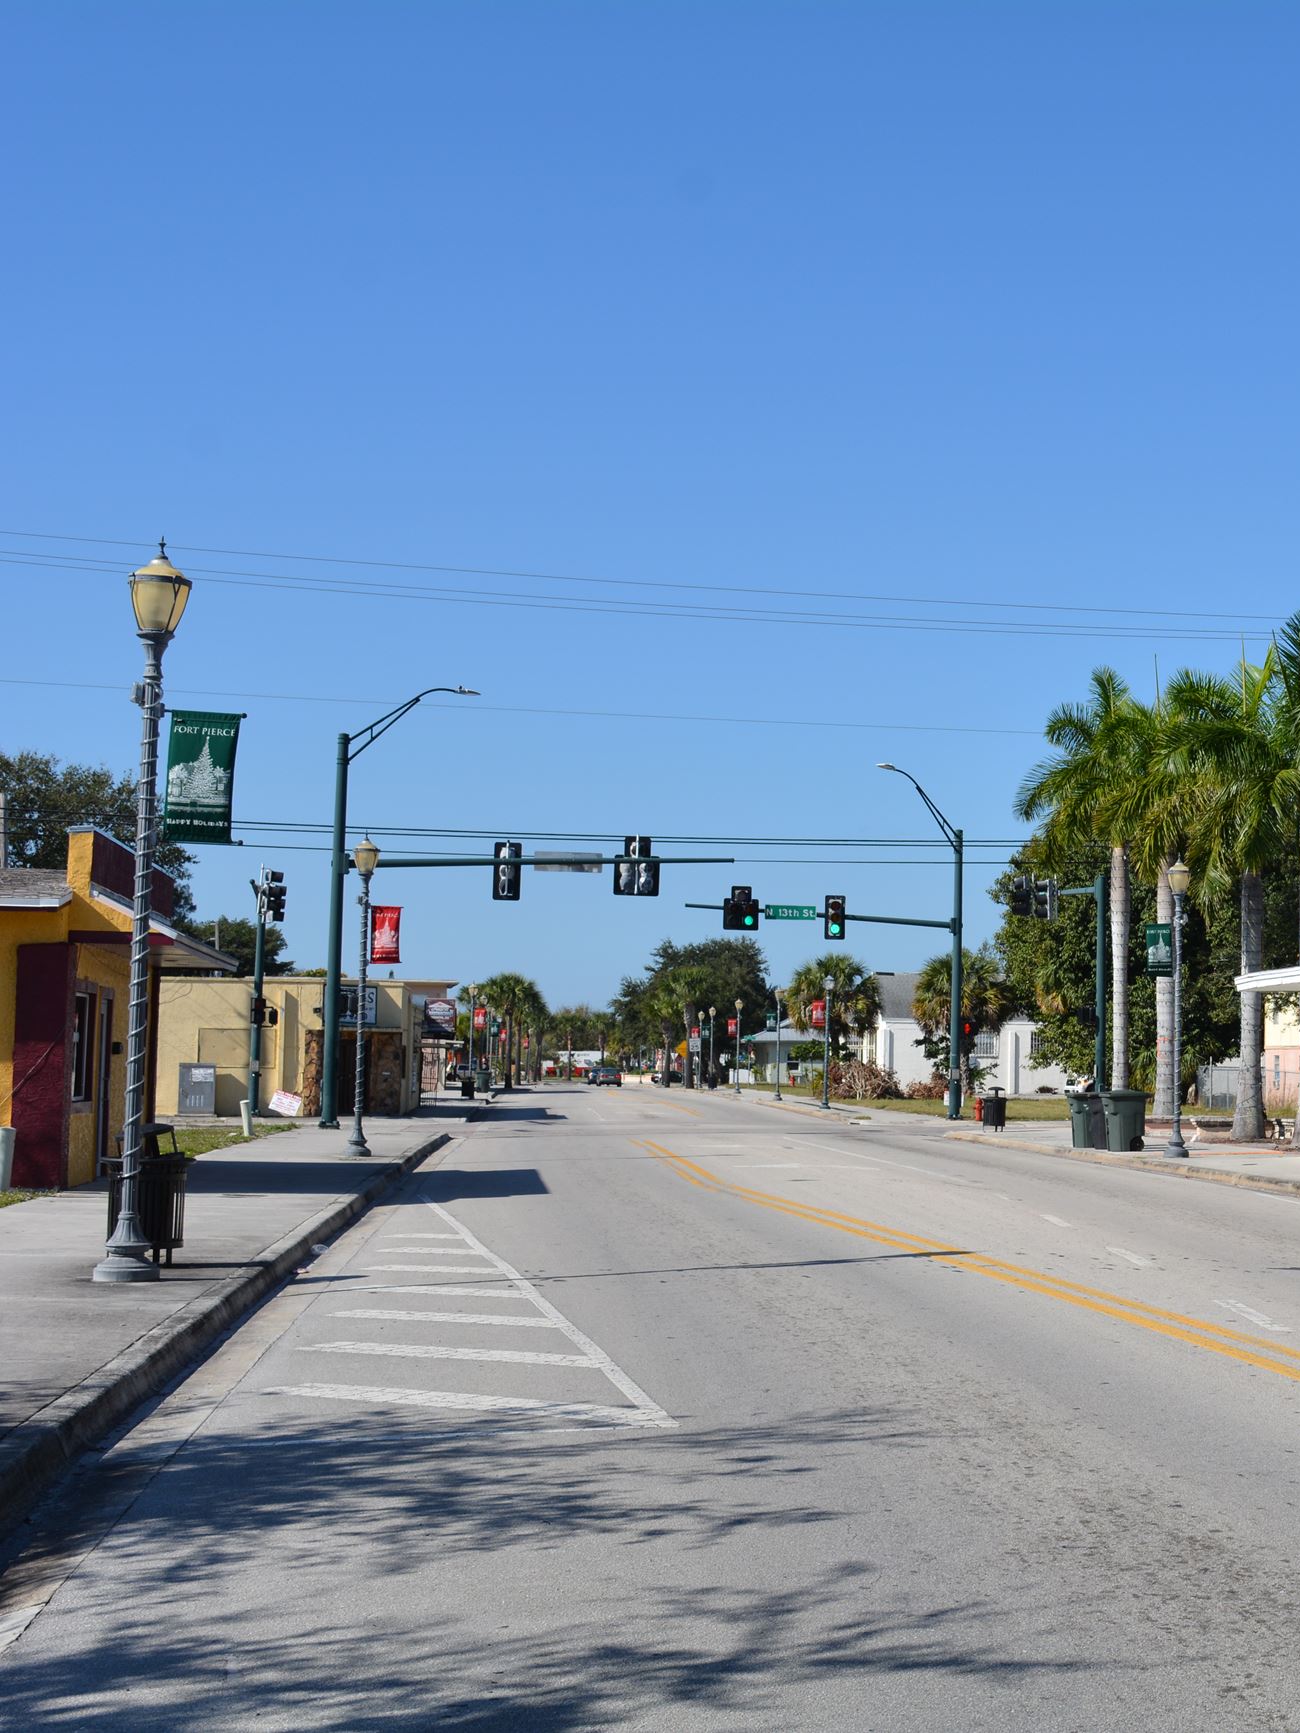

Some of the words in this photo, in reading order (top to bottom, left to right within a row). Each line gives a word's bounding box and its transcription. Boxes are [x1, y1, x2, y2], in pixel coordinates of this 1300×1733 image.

[174, 725, 200, 734] FORT
[202, 727, 236, 737] PIERCE
[166, 818, 191, 826] HAPPY
[193, 819, 228, 827] HOLIDAYS
[779, 908, 799, 917] 13th
[802, 909, 817, 918] St.
